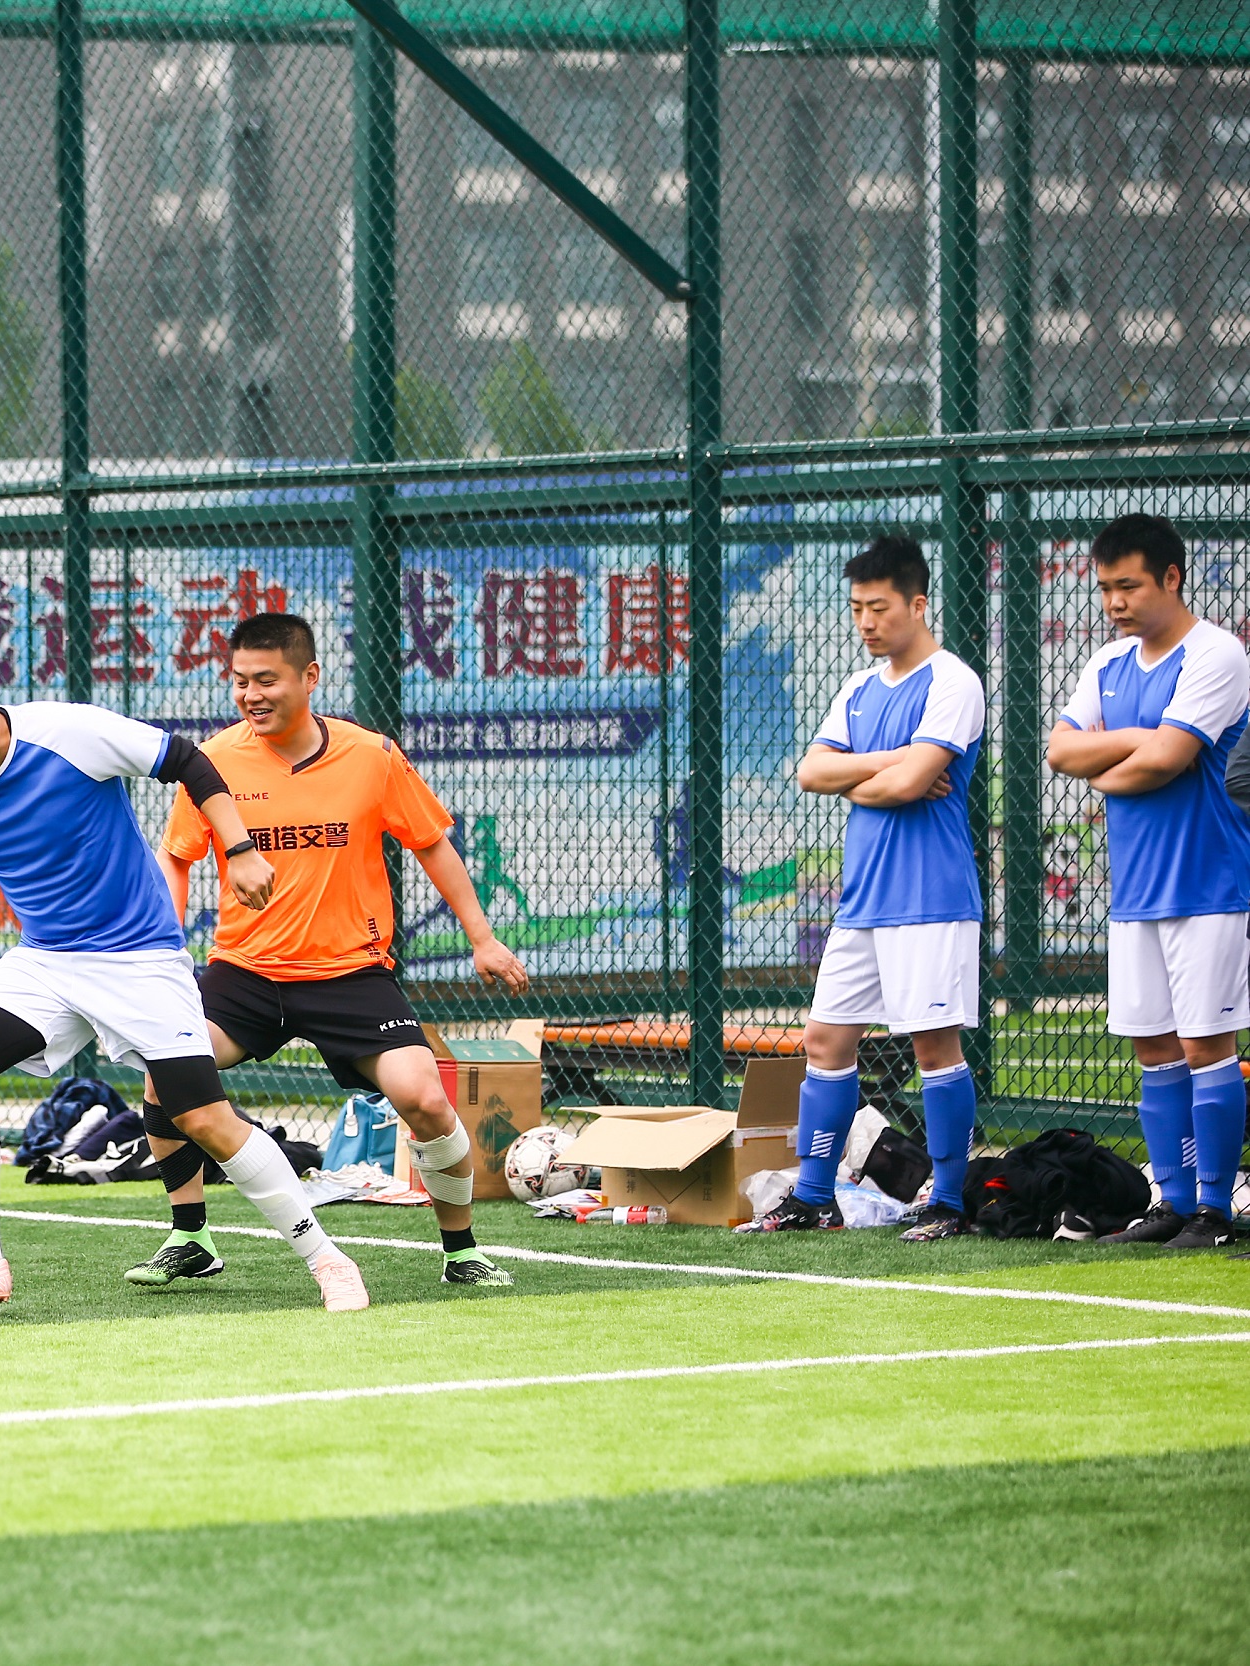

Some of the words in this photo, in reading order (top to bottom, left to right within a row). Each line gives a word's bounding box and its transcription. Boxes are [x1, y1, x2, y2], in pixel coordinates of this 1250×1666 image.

[234, 792, 269, 801] ELME
[246, 821, 350, 852] 雁塔交警
[379, 1018, 419, 1032] KELME
